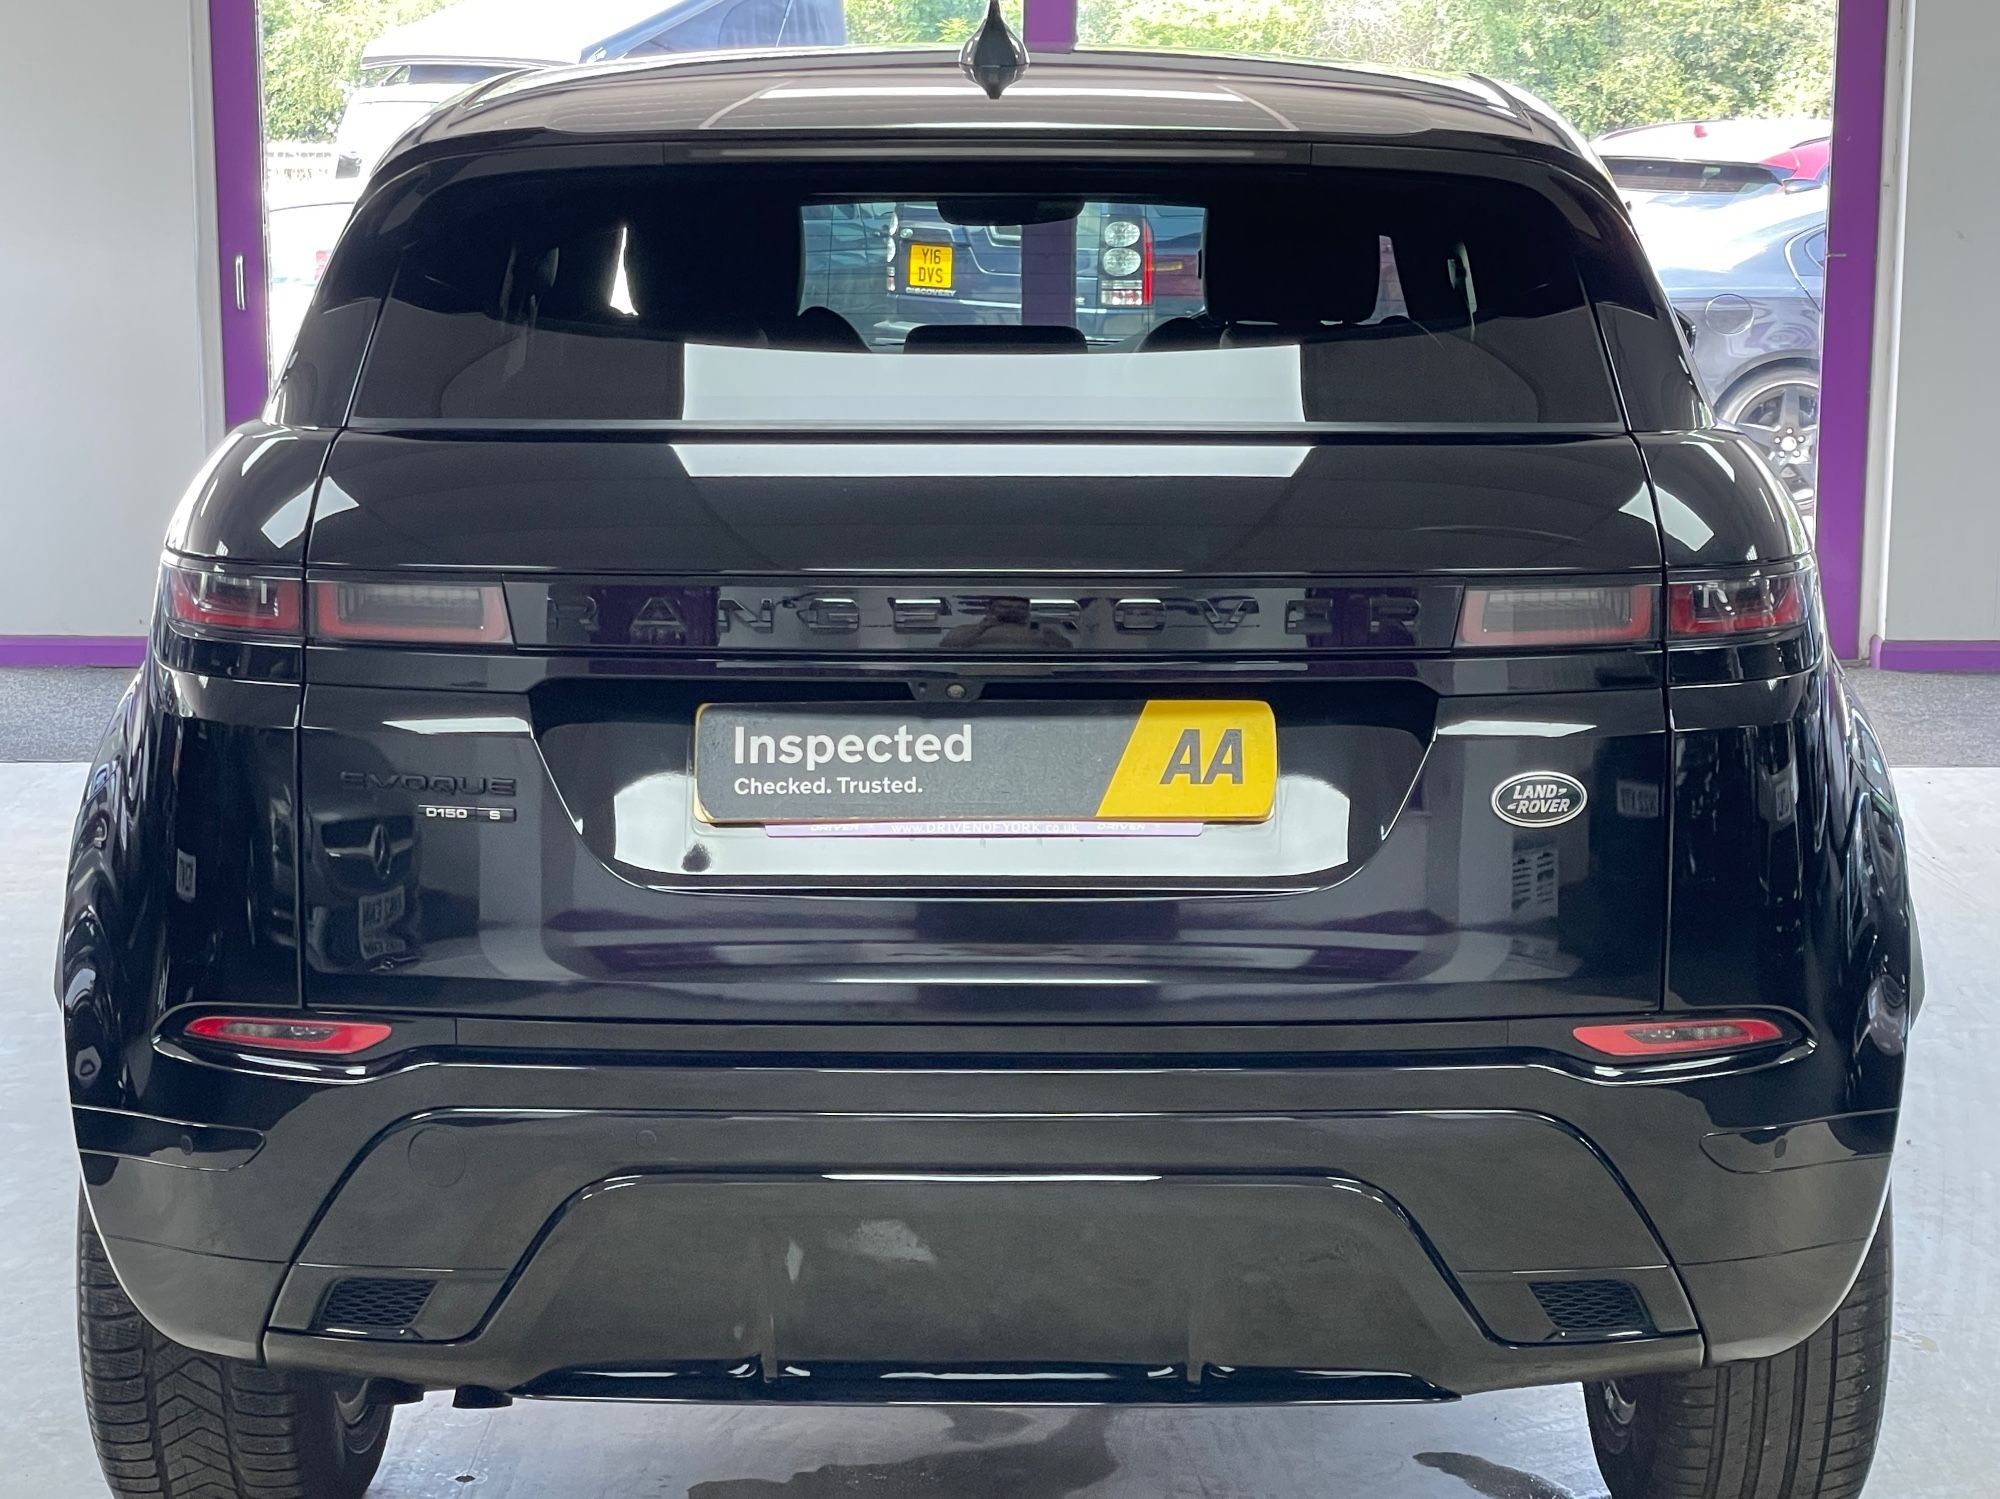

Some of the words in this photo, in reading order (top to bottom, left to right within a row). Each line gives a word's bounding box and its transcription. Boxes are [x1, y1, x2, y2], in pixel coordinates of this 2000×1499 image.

[922, 248, 941, 265] Y16
[918, 266, 943, 284] DVS
[547, 596, 943, 635] RANGE
[1030, 597, 1422, 635] ROVER
[733, 724, 973, 771] Inspected
[1159, 728, 1245, 786] AA
[340, 771, 517, 797] EVOQUE
[733, 776, 832, 796] Checked.
[836, 775, 923, 795] Trusted.
[1513, 784, 1558, 800] LAND
[426, 807, 468, 819] D150
[489, 810, 501, 820] S
[1516, 798, 1571, 814] ROVER
